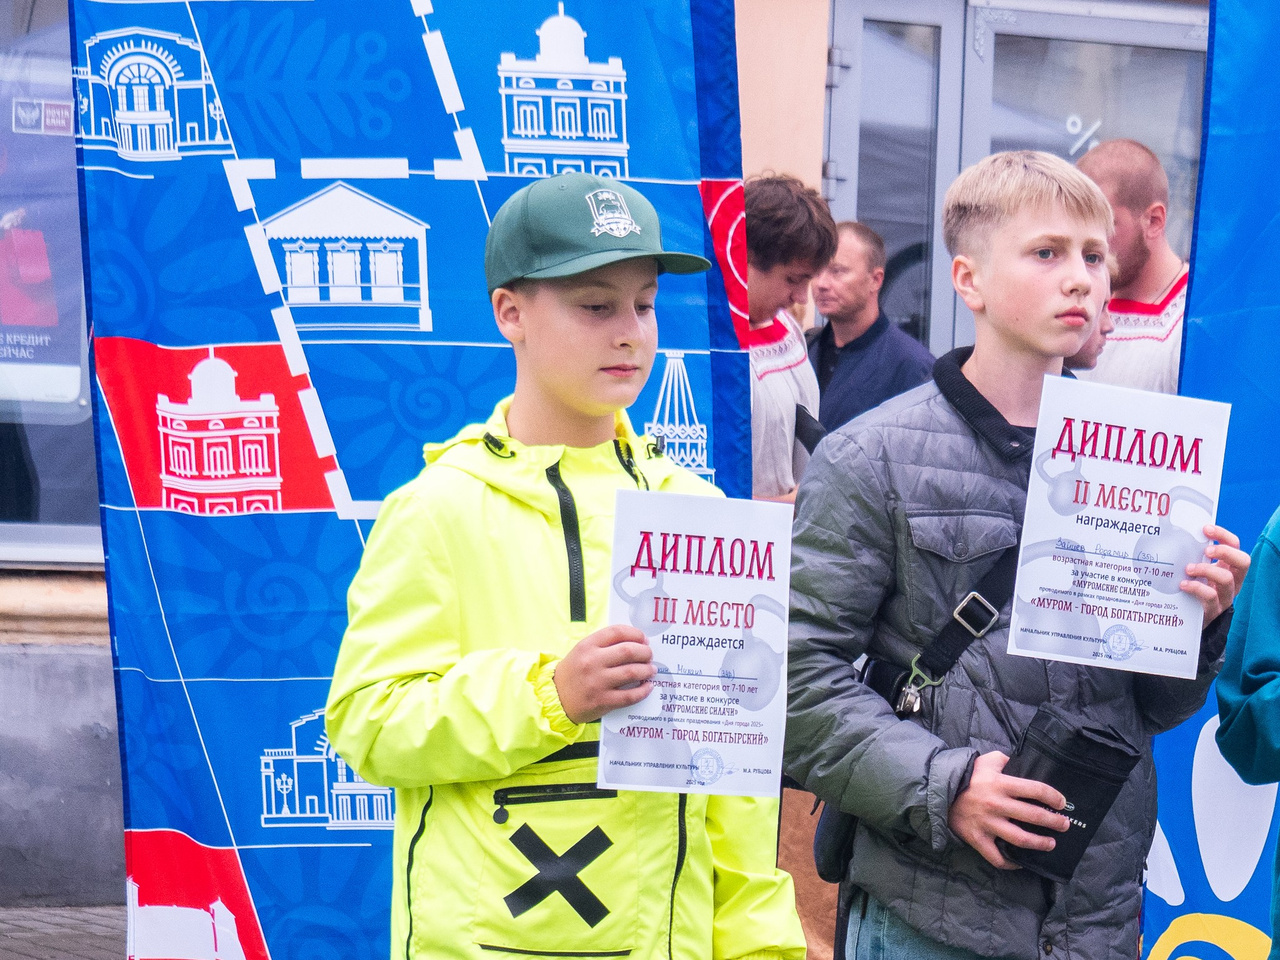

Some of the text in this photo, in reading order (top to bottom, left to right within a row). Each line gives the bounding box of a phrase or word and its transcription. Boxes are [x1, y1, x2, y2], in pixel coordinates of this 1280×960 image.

[1051, 417, 1203, 475] ДИПЛОМ
[1073, 480, 1171, 517] II МЕСТО
[1075, 513, 1161, 536] награждается
[630, 531, 776, 582] ДИПЛОМ
[1052, 553, 1173, 578] возрастная категория от 7-10 лет
[1079, 570, 1109, 583] участие
[1117, 576, 1151, 589] конкурсе
[1038, 586, 1072, 596] проводимого
[1077, 592, 1094, 600] рамках
[1096, 594, 1130, 605] празднования
[1144, 601, 1162, 610] города
[1119, 585, 1150, 597] СИЛАЧИ»
[652, 596, 755, 629] III МЕСТО
[1030, 596, 1073, 611] «МУРОМ
[1080, 603, 1109, 619] ГОРОД
[1110, 605, 1184, 628] БОГАТЫРСКИЙ»
[661, 633, 745, 650] награждается
[1050, 631, 1082, 641] УПРАВЛЕНИЯ
[639, 677, 681, 689] растная
[683, 681, 720, 692] категория
[731, 683, 745, 692] 7-10
[670, 694, 698, 704] участие
[706, 696, 739, 707] конкурсе
[627, 714, 662, 722] проводимого
[688, 718, 720, 726] празднования
[709, 706, 738, 716] СИЛАЧИ»
[619, 726, 663, 739] «МУРОМ
[671, 729, 700, 743] ГОРОД
[701, 728, 768, 745] БОГАТЫРСКИЙ»
[609, 759, 641, 767] НАЧАЛЬНИК
